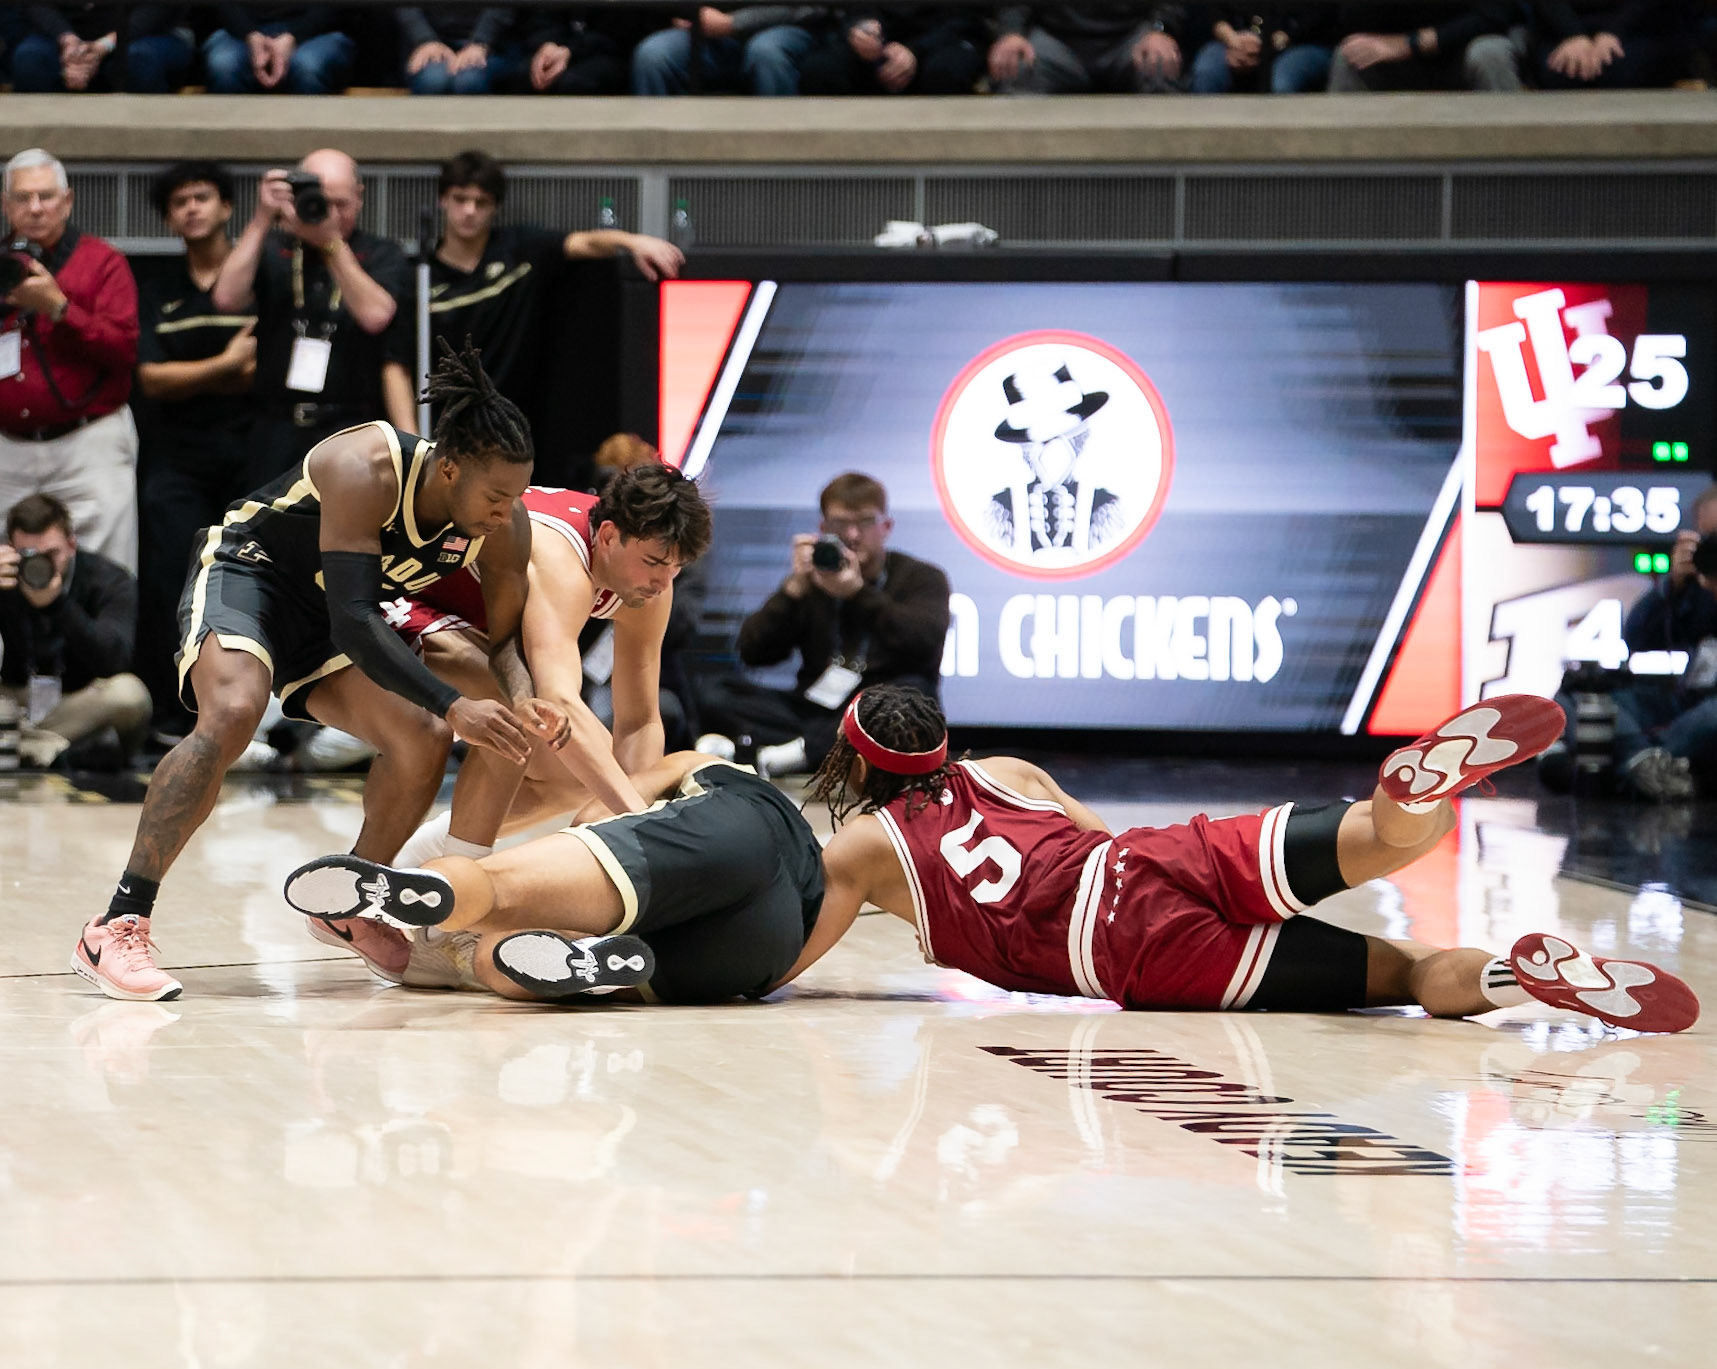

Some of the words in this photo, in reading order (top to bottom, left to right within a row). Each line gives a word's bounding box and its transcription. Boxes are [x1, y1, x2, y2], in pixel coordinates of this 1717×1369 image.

[1569, 334, 1690, 409] 25
[1525, 485, 1682, 533] 17:35
[998, 593, 1285, 685] CHICKENS
[940, 808, 1023, 904] 5
